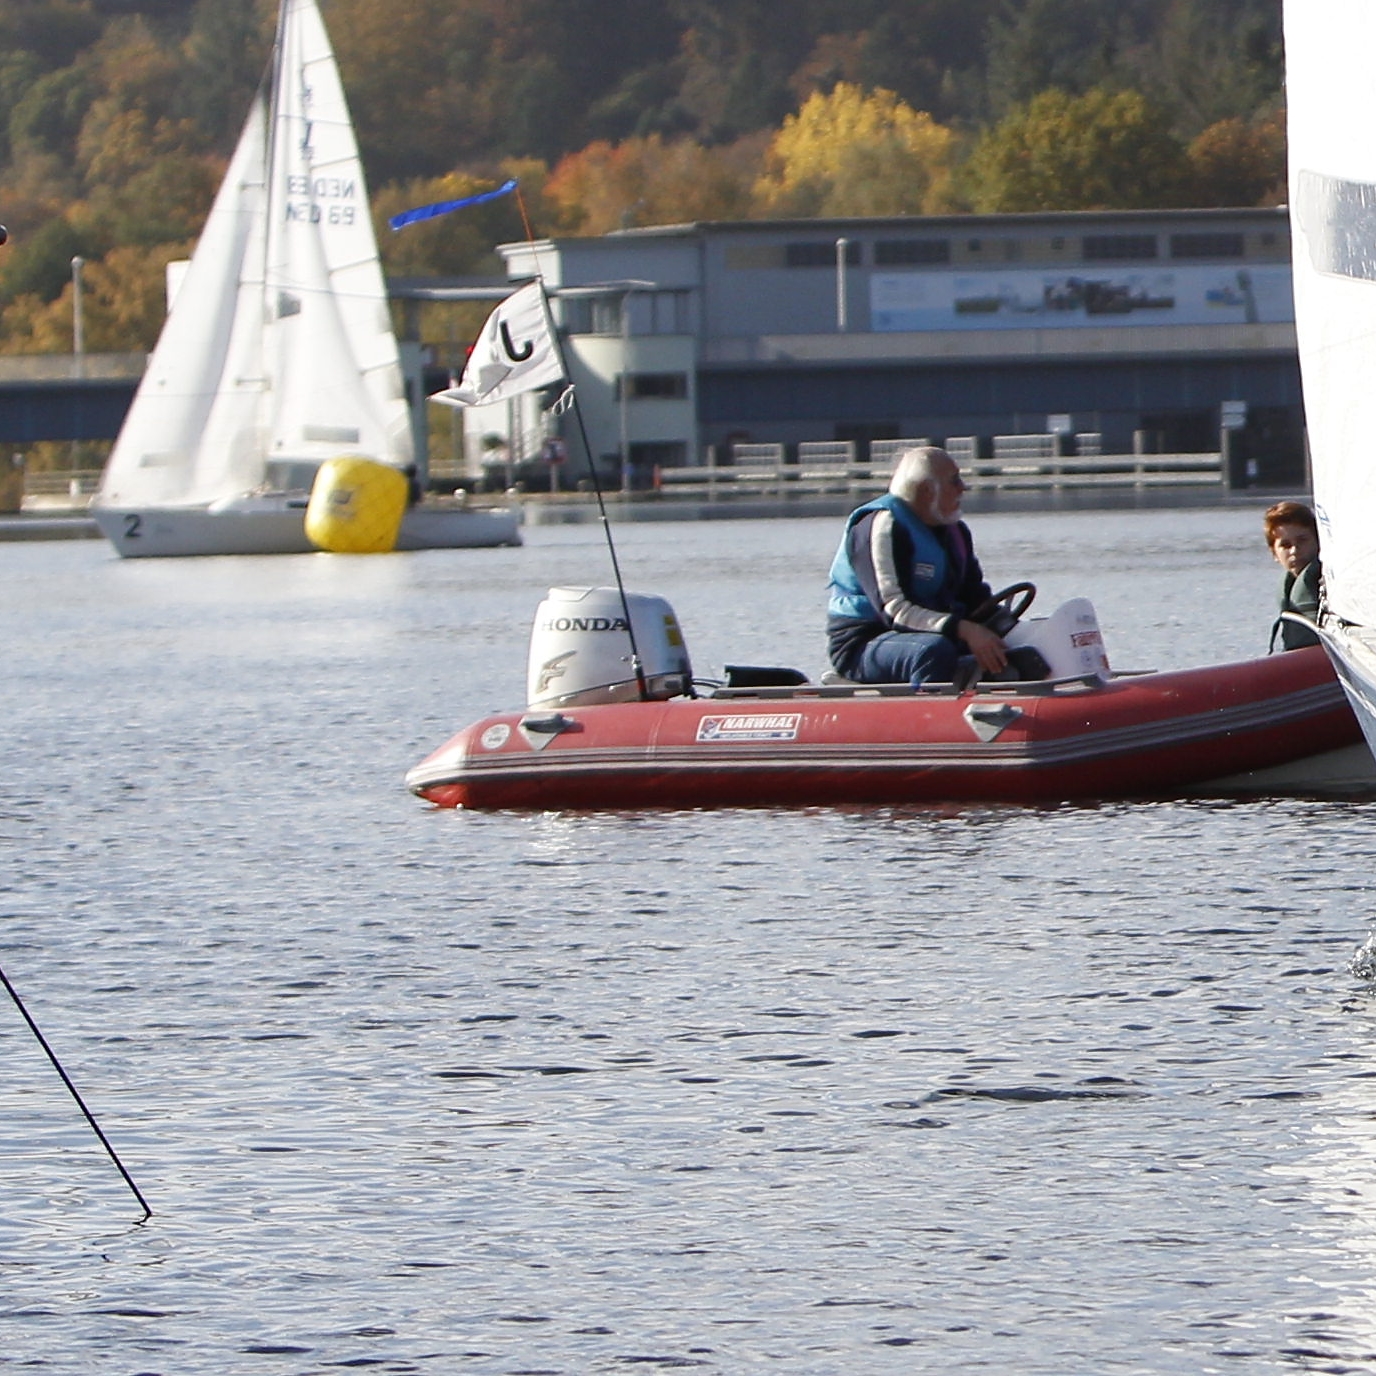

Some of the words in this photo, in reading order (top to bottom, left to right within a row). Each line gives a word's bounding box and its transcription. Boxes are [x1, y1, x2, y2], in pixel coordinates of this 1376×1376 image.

[123, 512, 142, 539] 2
[541, 617, 631, 632] HONDA
[721, 715, 796, 730] NARWHAL
